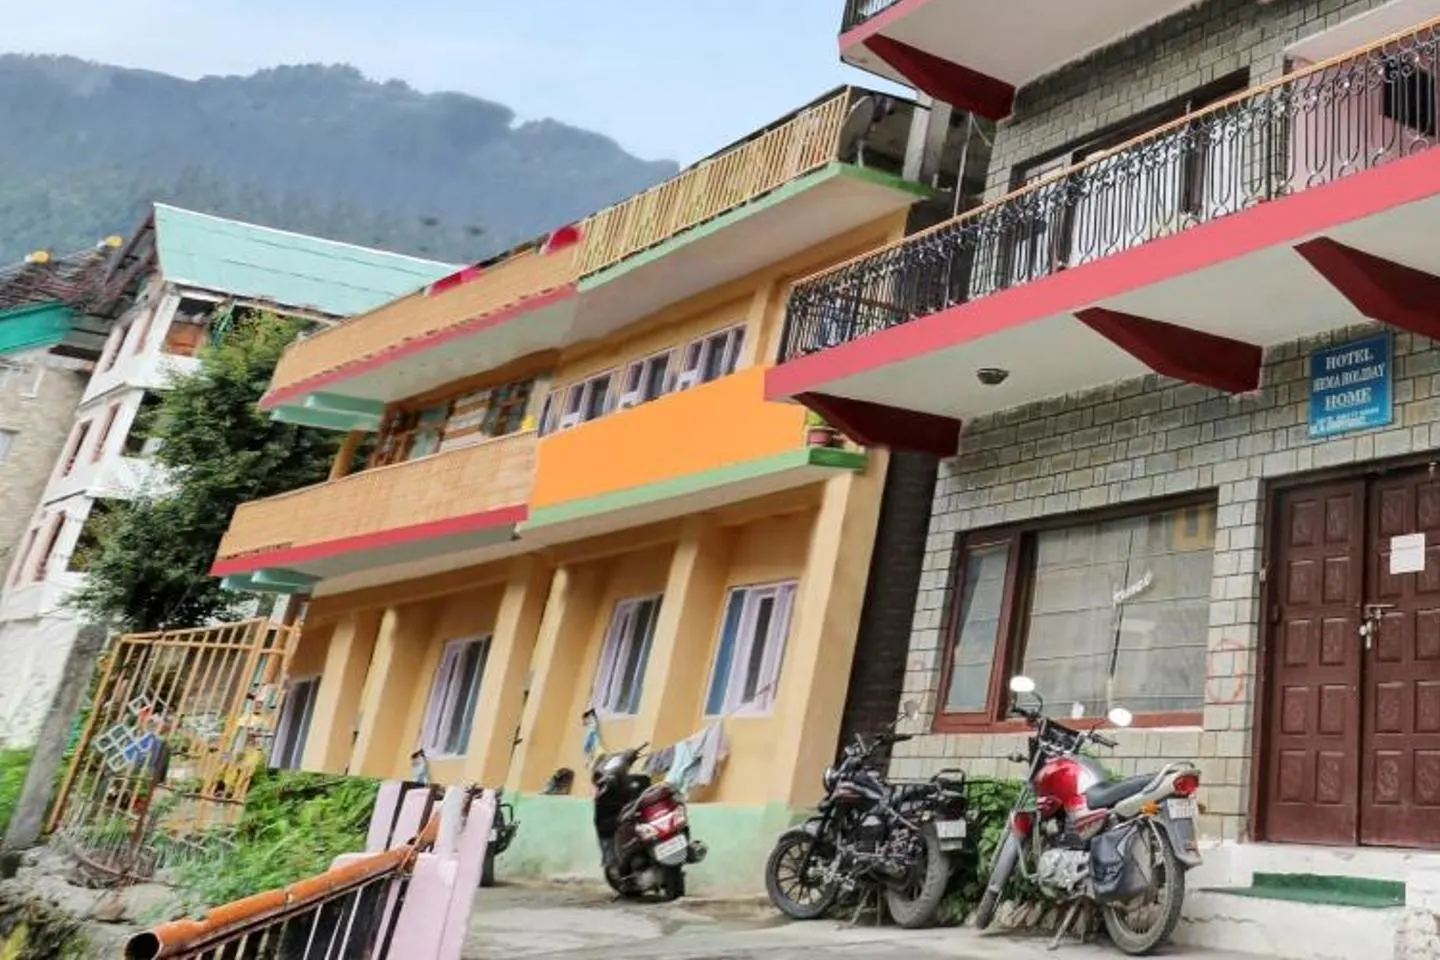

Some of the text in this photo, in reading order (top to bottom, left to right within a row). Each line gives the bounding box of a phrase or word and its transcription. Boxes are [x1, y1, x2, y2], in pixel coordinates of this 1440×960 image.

[1326, 348, 1374, 370] HOTEL
[1341, 363, 1386, 386] HOLIDAY
[1325, 387, 1372, 411] HOME
